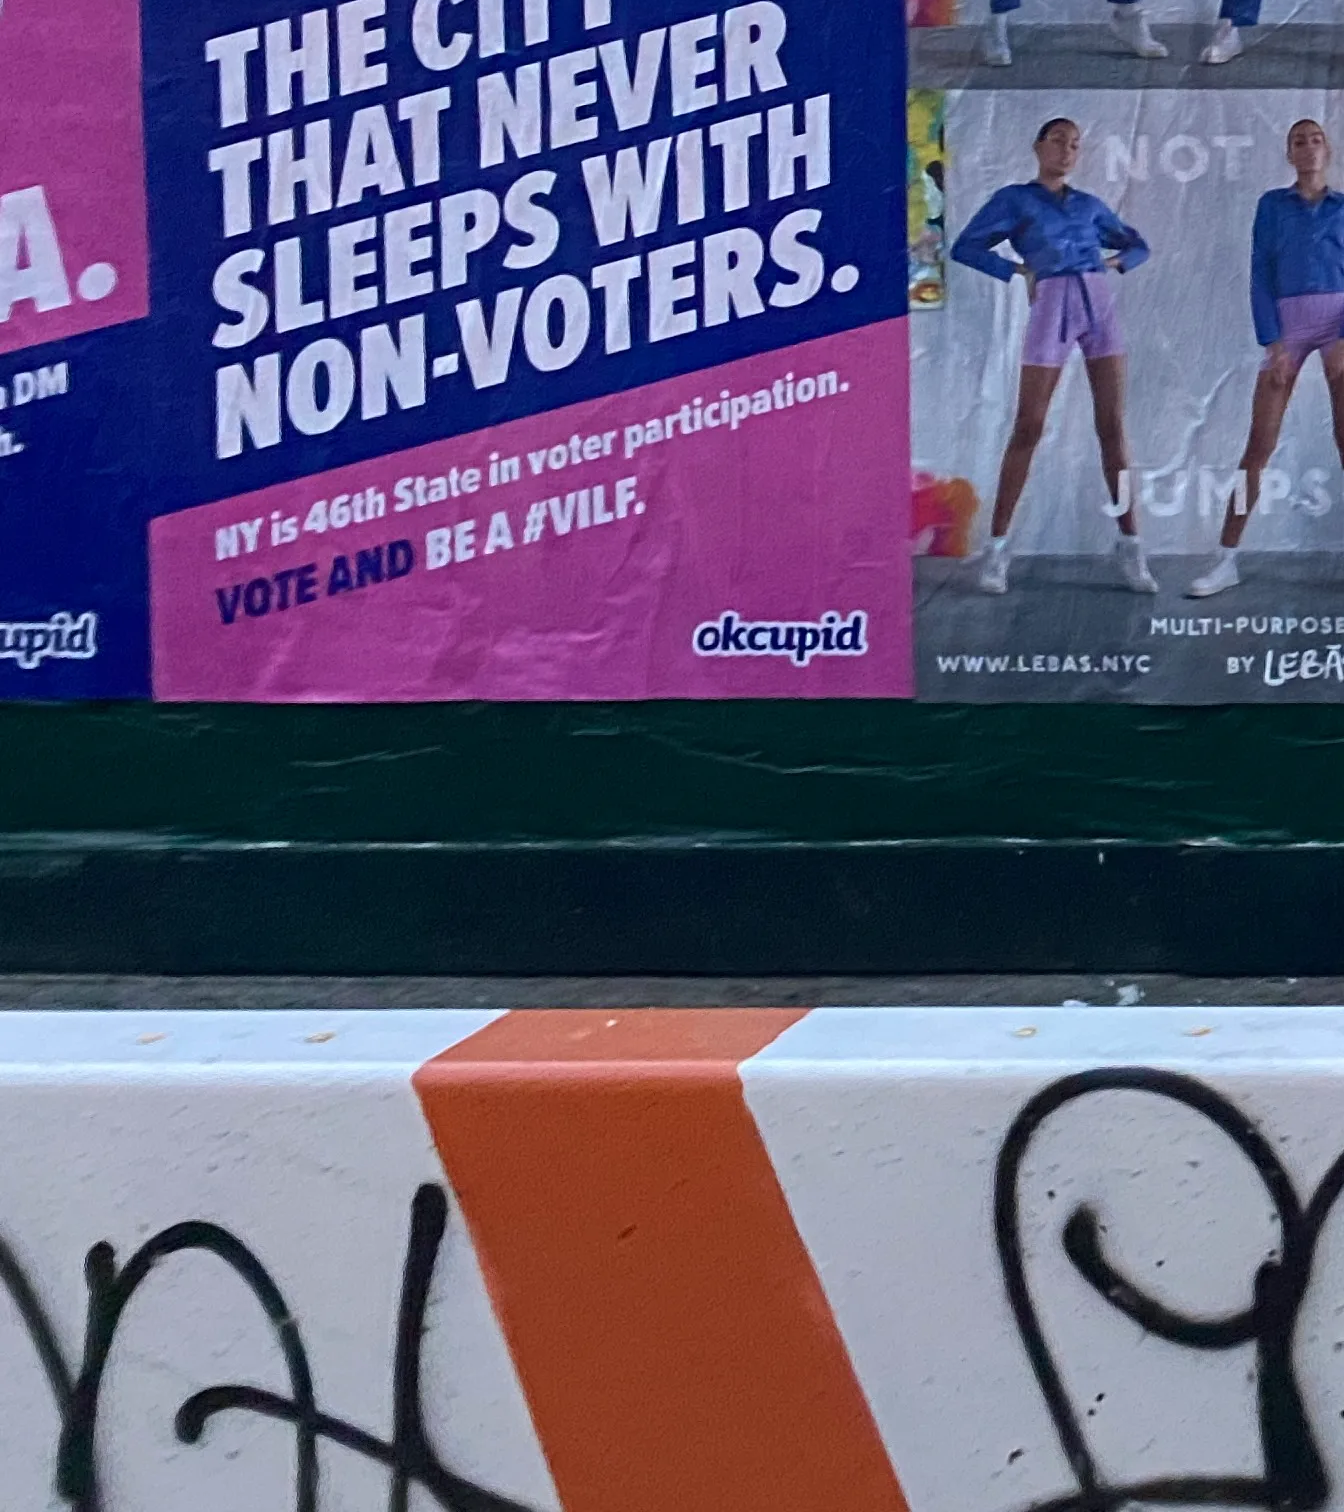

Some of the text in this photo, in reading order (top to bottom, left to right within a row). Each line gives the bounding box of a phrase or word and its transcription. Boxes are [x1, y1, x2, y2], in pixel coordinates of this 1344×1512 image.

[208, 0, 788, 238] THAT NEVER
[1101, 135, 1253, 183] NOT
[212, 94, 832, 348] SLEEPS WITH
[13, 359, 69, 406] DM
[214, 209, 861, 460] NON-VOTERS.
[215, 375, 850, 560] NY is 46th State in voter participation.
[216, 476, 646, 626] VOTE AND BE A #VILF.
[692, 611, 868, 665] okcupid
[938, 654, 1151, 673] WWW.LEBAS.NYC
[1227, 656, 1254, 674] BY
